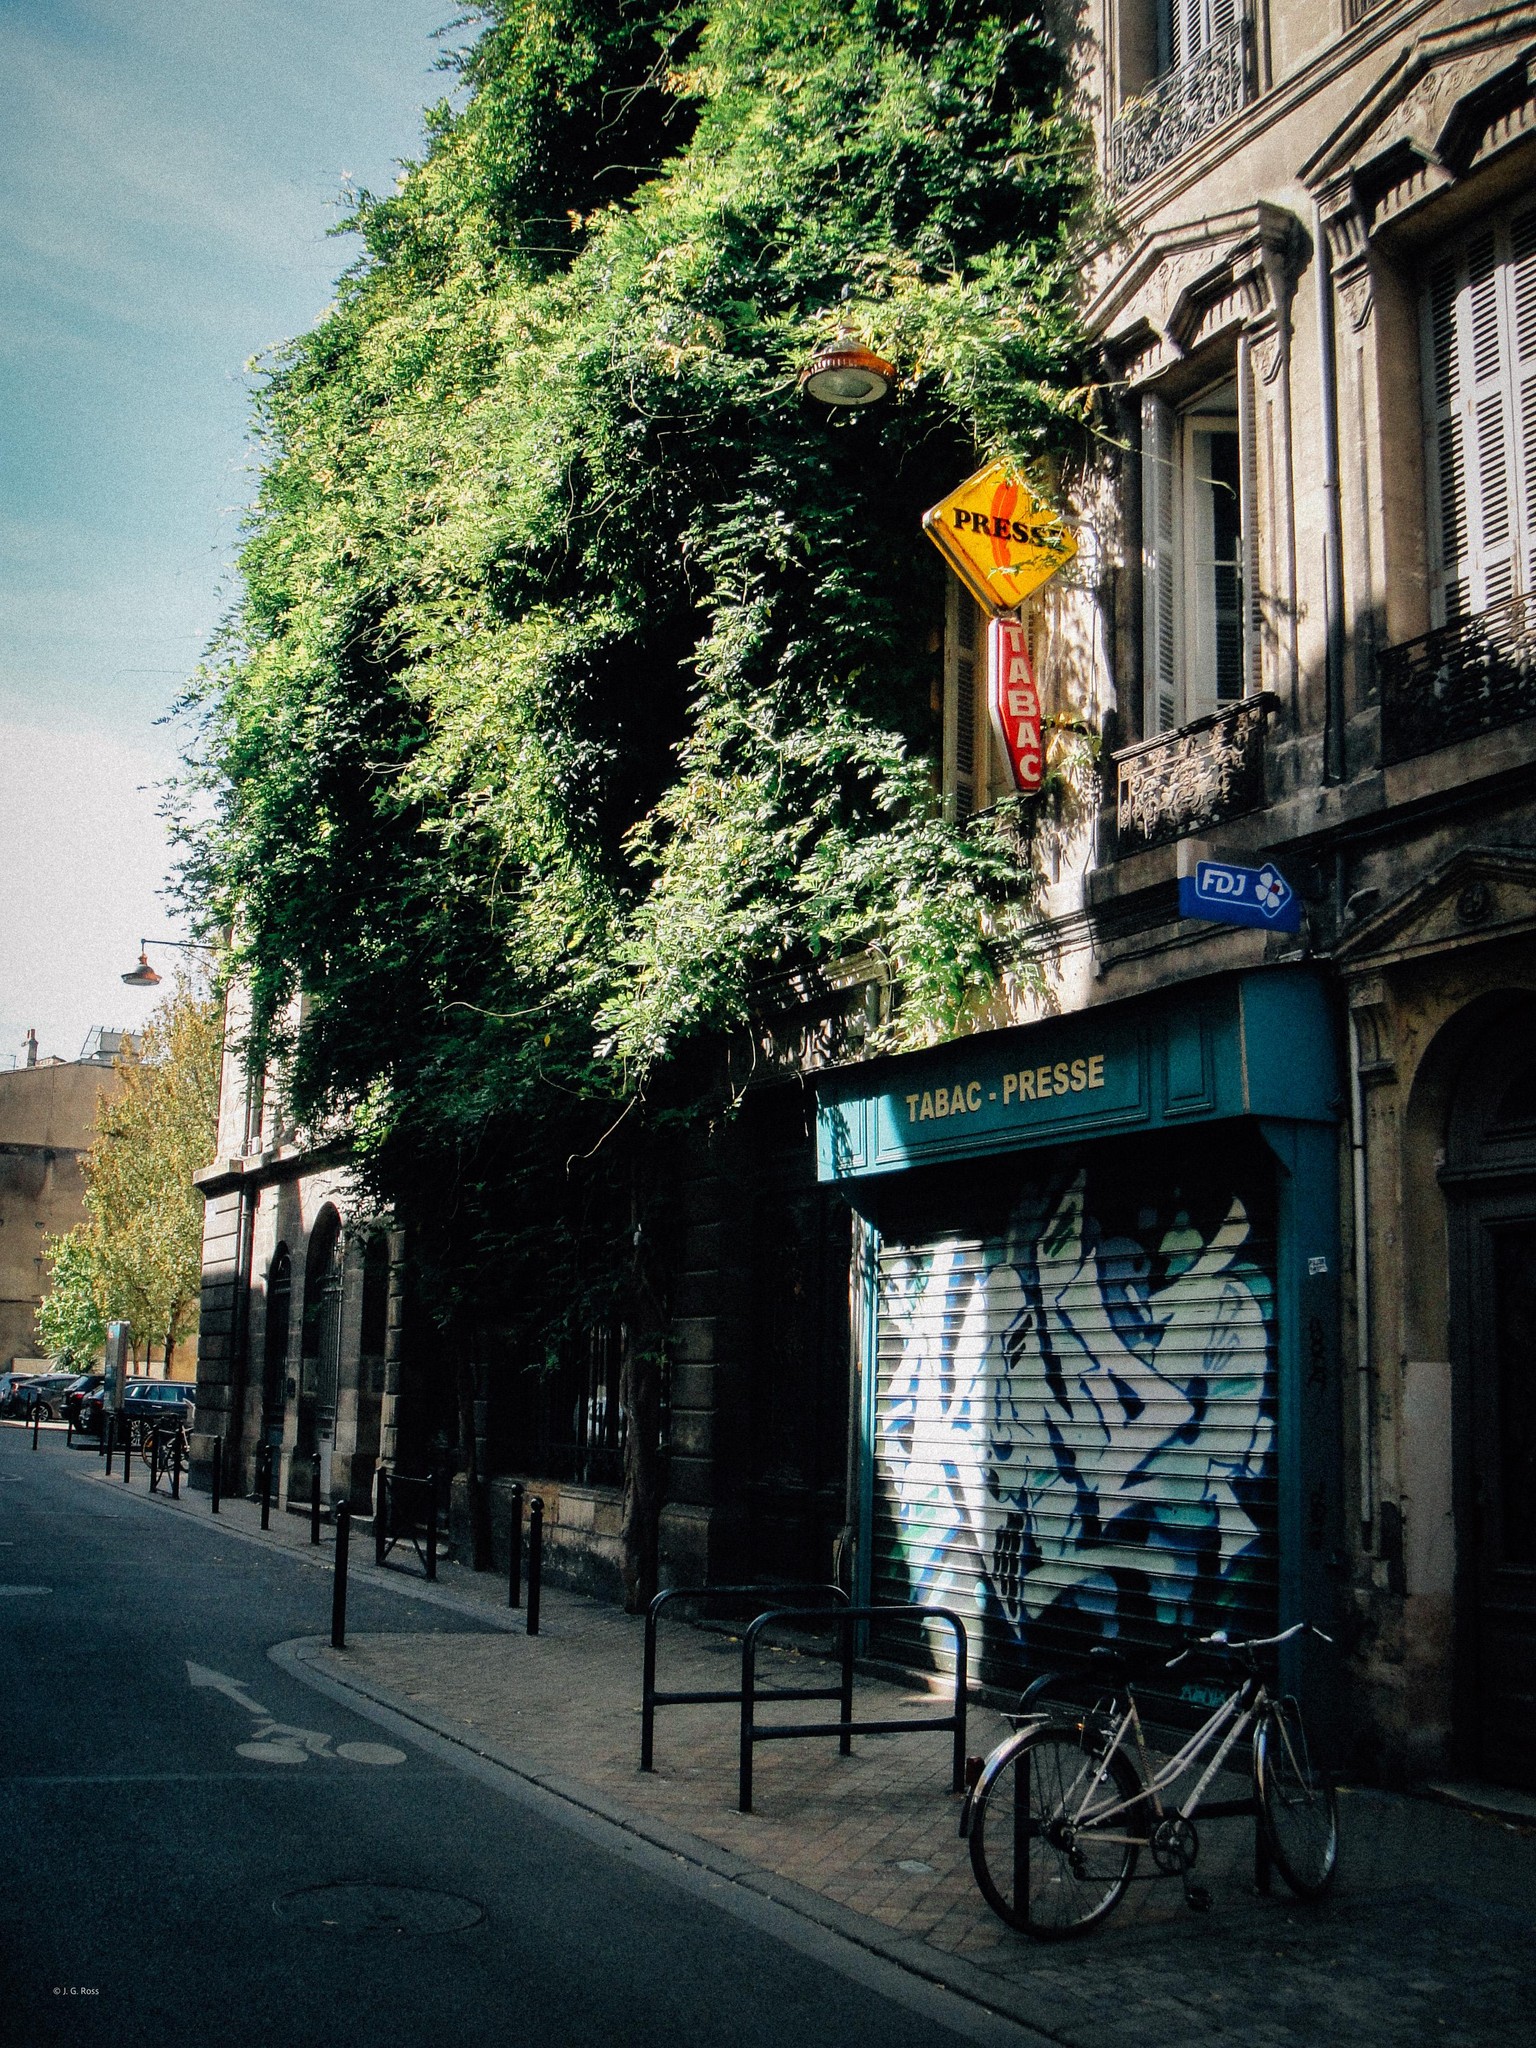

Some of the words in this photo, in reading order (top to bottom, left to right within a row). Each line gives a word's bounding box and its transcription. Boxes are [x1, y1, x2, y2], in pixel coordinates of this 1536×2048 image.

[1005, 627, 1040, 782] TABAC
[1202, 868, 1246, 896] FDJ
[906, 1081, 982, 1122] TABAC
[1003, 1054, 1105, 1105] PRESSE
